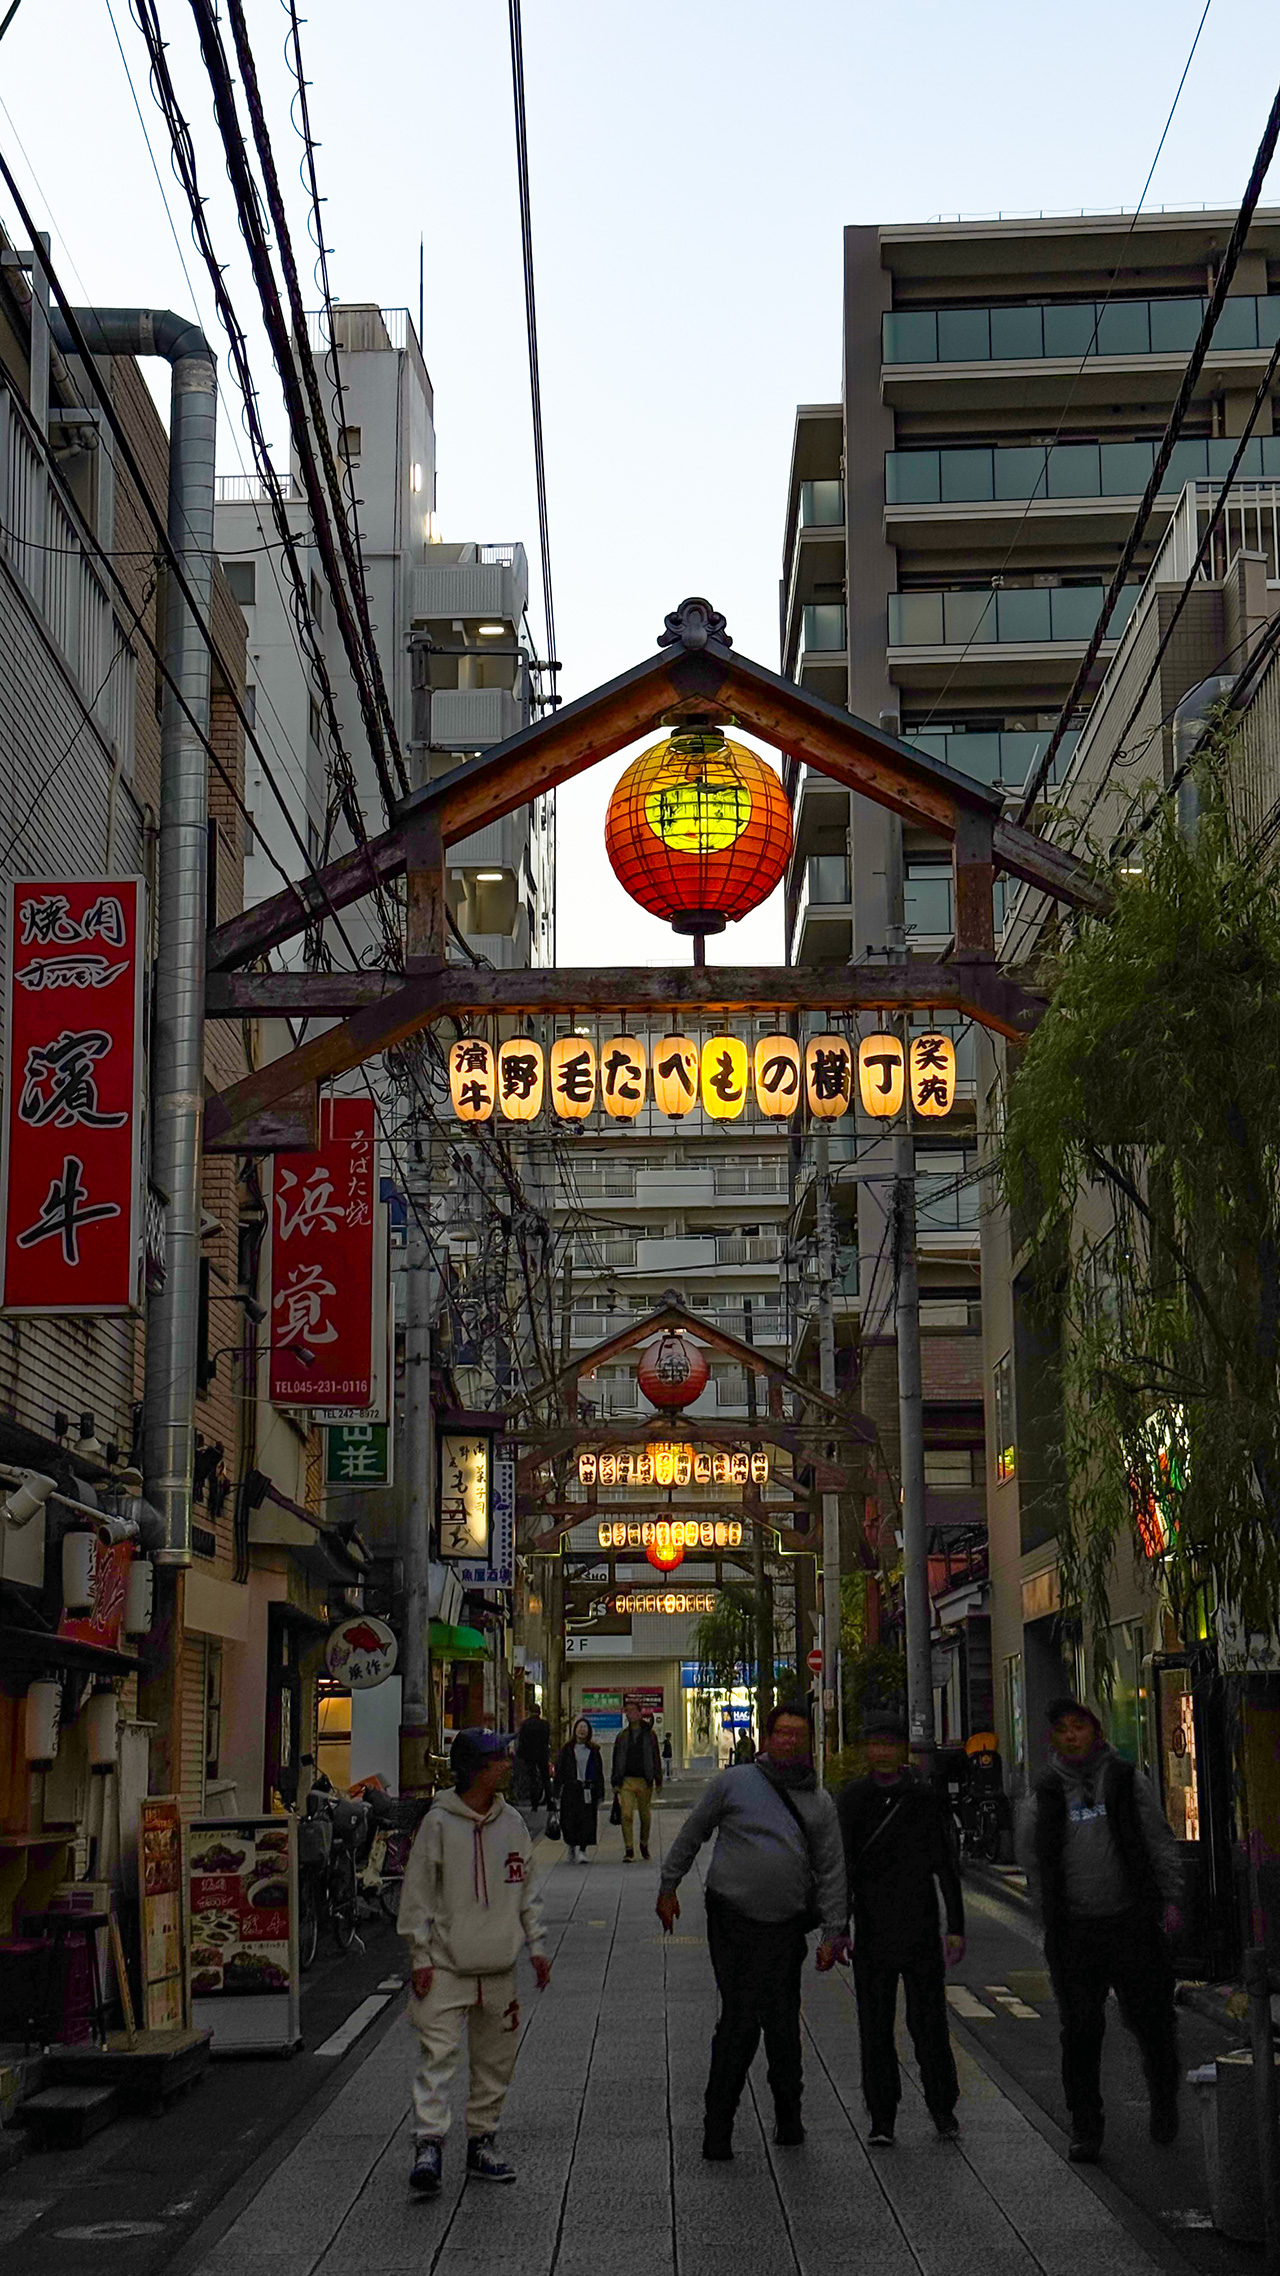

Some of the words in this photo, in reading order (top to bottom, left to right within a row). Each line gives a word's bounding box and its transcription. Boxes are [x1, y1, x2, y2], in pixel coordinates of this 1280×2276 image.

[20, 895, 126, 947] 焼肉
[462, 1568, 512, 1583] 魚屋酒場
